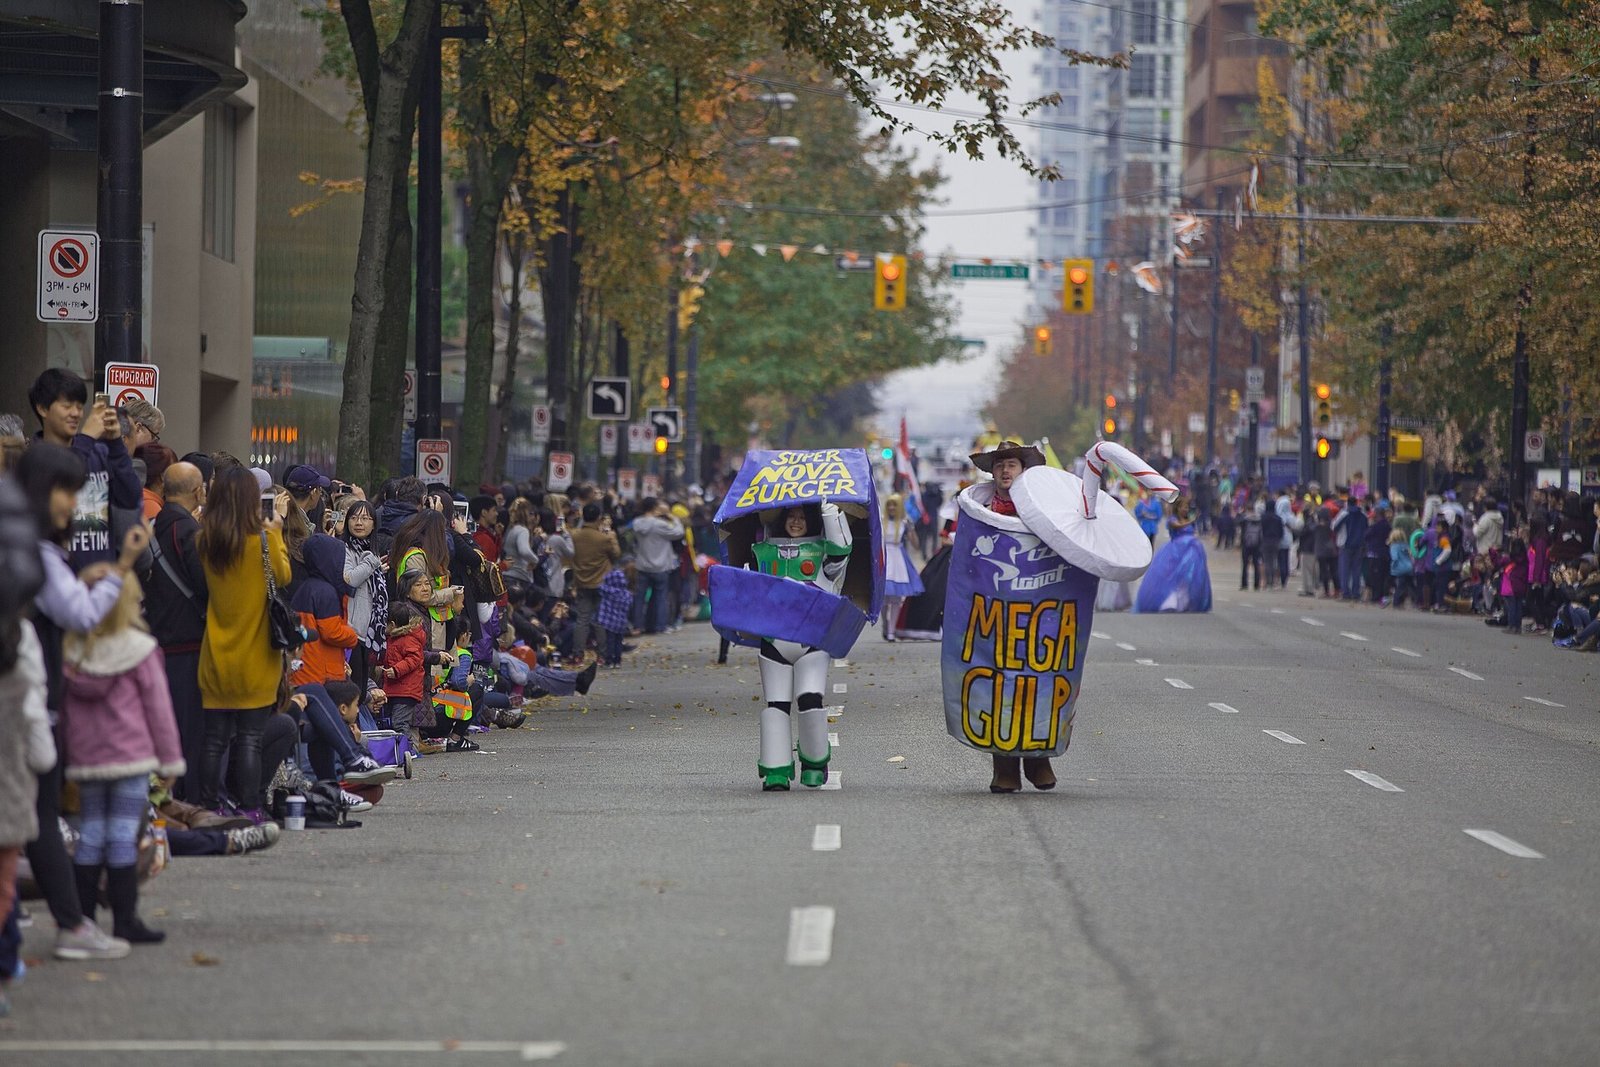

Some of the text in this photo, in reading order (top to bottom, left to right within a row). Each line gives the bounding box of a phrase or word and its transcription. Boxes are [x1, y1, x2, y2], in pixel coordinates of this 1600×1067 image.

[46, 281, 64, 292] 3PM
[72, 282, 91, 294] 6PM
[110, 369, 154, 386] TEMPORARY
[770, 450, 843, 466] SUPER
[749, 462, 852, 487] NOVA
[735, 479, 858, 508] BURGER
[962, 592, 1078, 673] MEGA
[961, 666, 1072, 752] GULP
